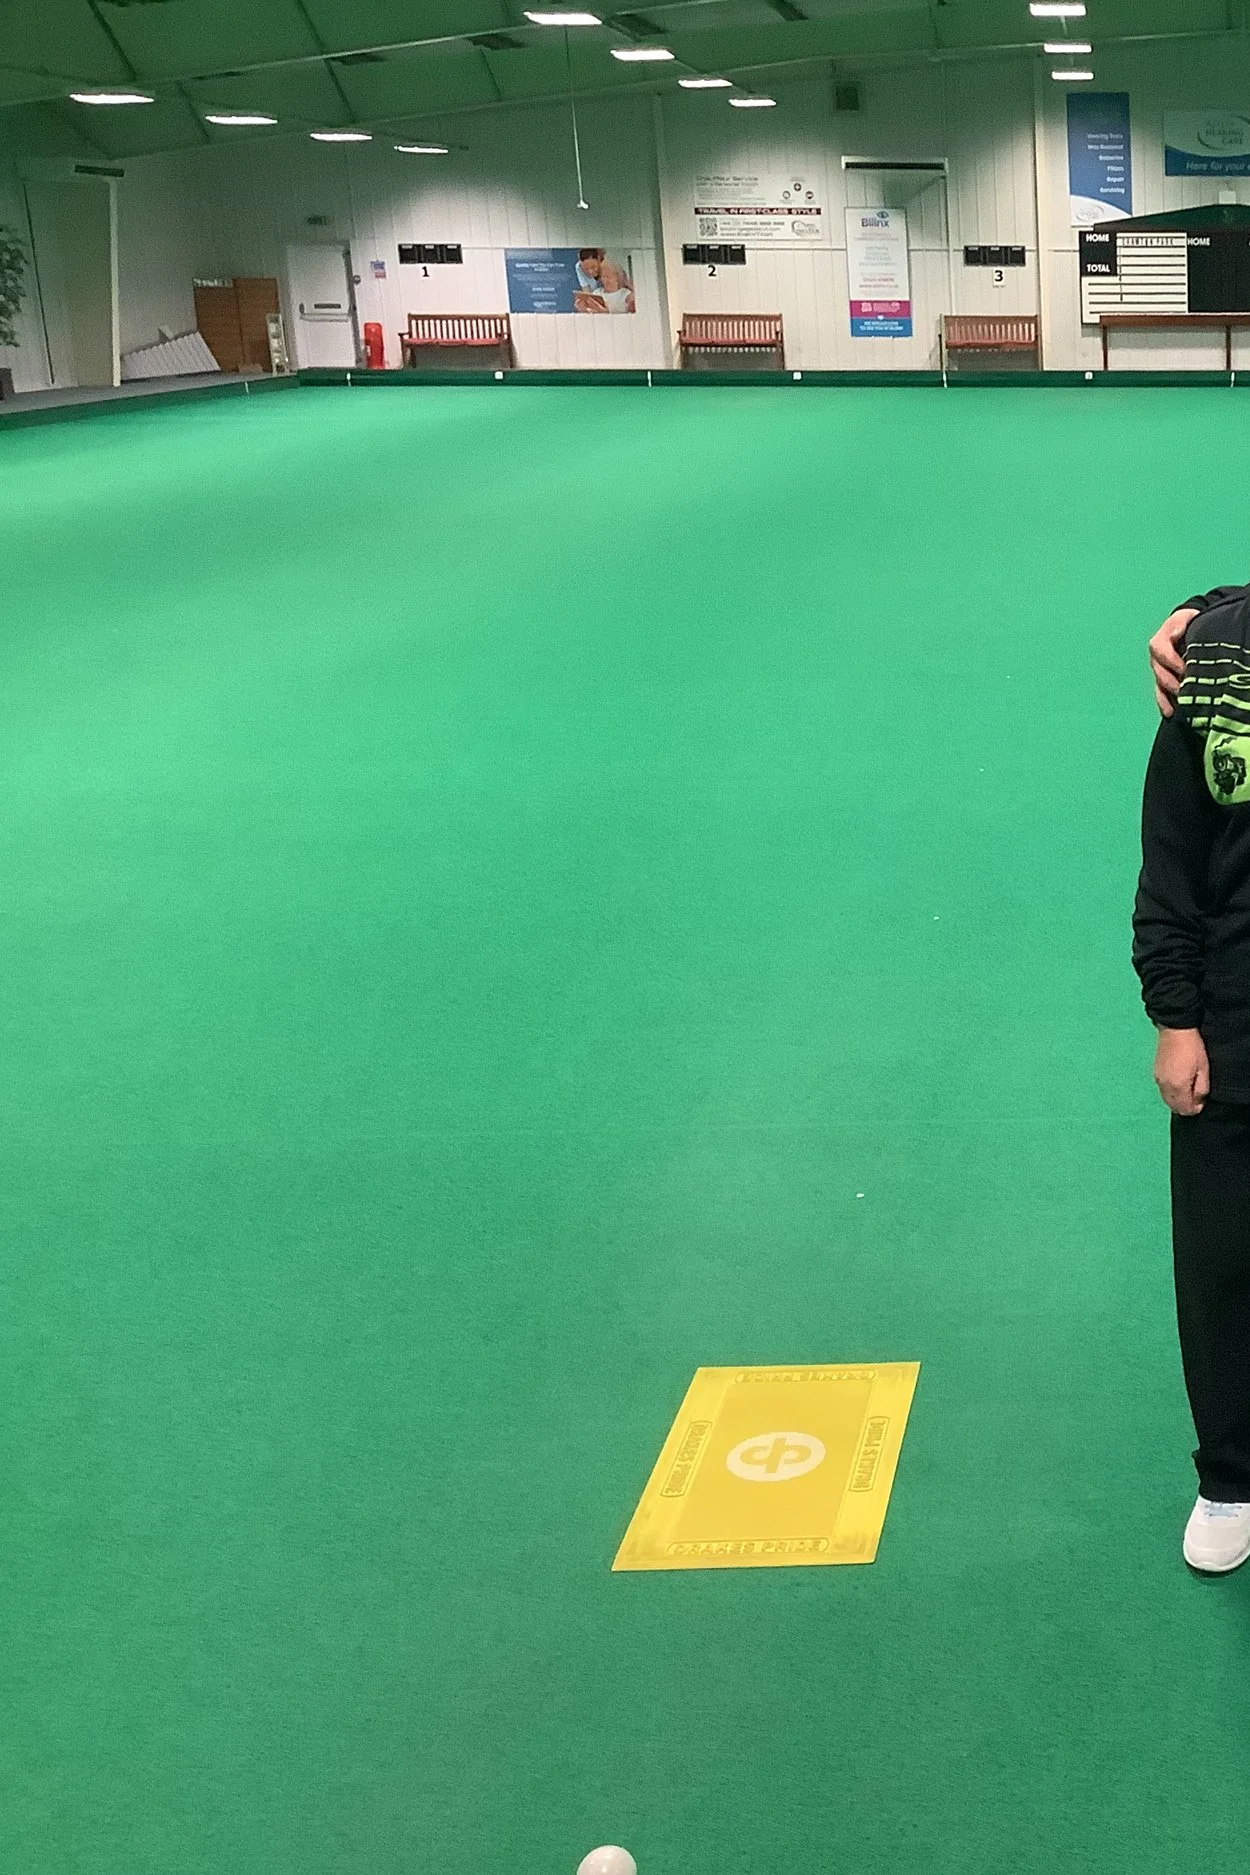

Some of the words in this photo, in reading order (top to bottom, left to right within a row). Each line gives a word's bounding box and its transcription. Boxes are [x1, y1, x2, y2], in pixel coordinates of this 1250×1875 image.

[1210, 161, 1222, 170] for
[1085, 233, 1110, 242] HOME
[1187, 237, 1210, 246] HOME
[421, 266, 430, 277] 1
[707, 265, 717, 277] 2
[1086, 263, 1111, 273] TOTAL
[994, 270, 1004, 282] 3
